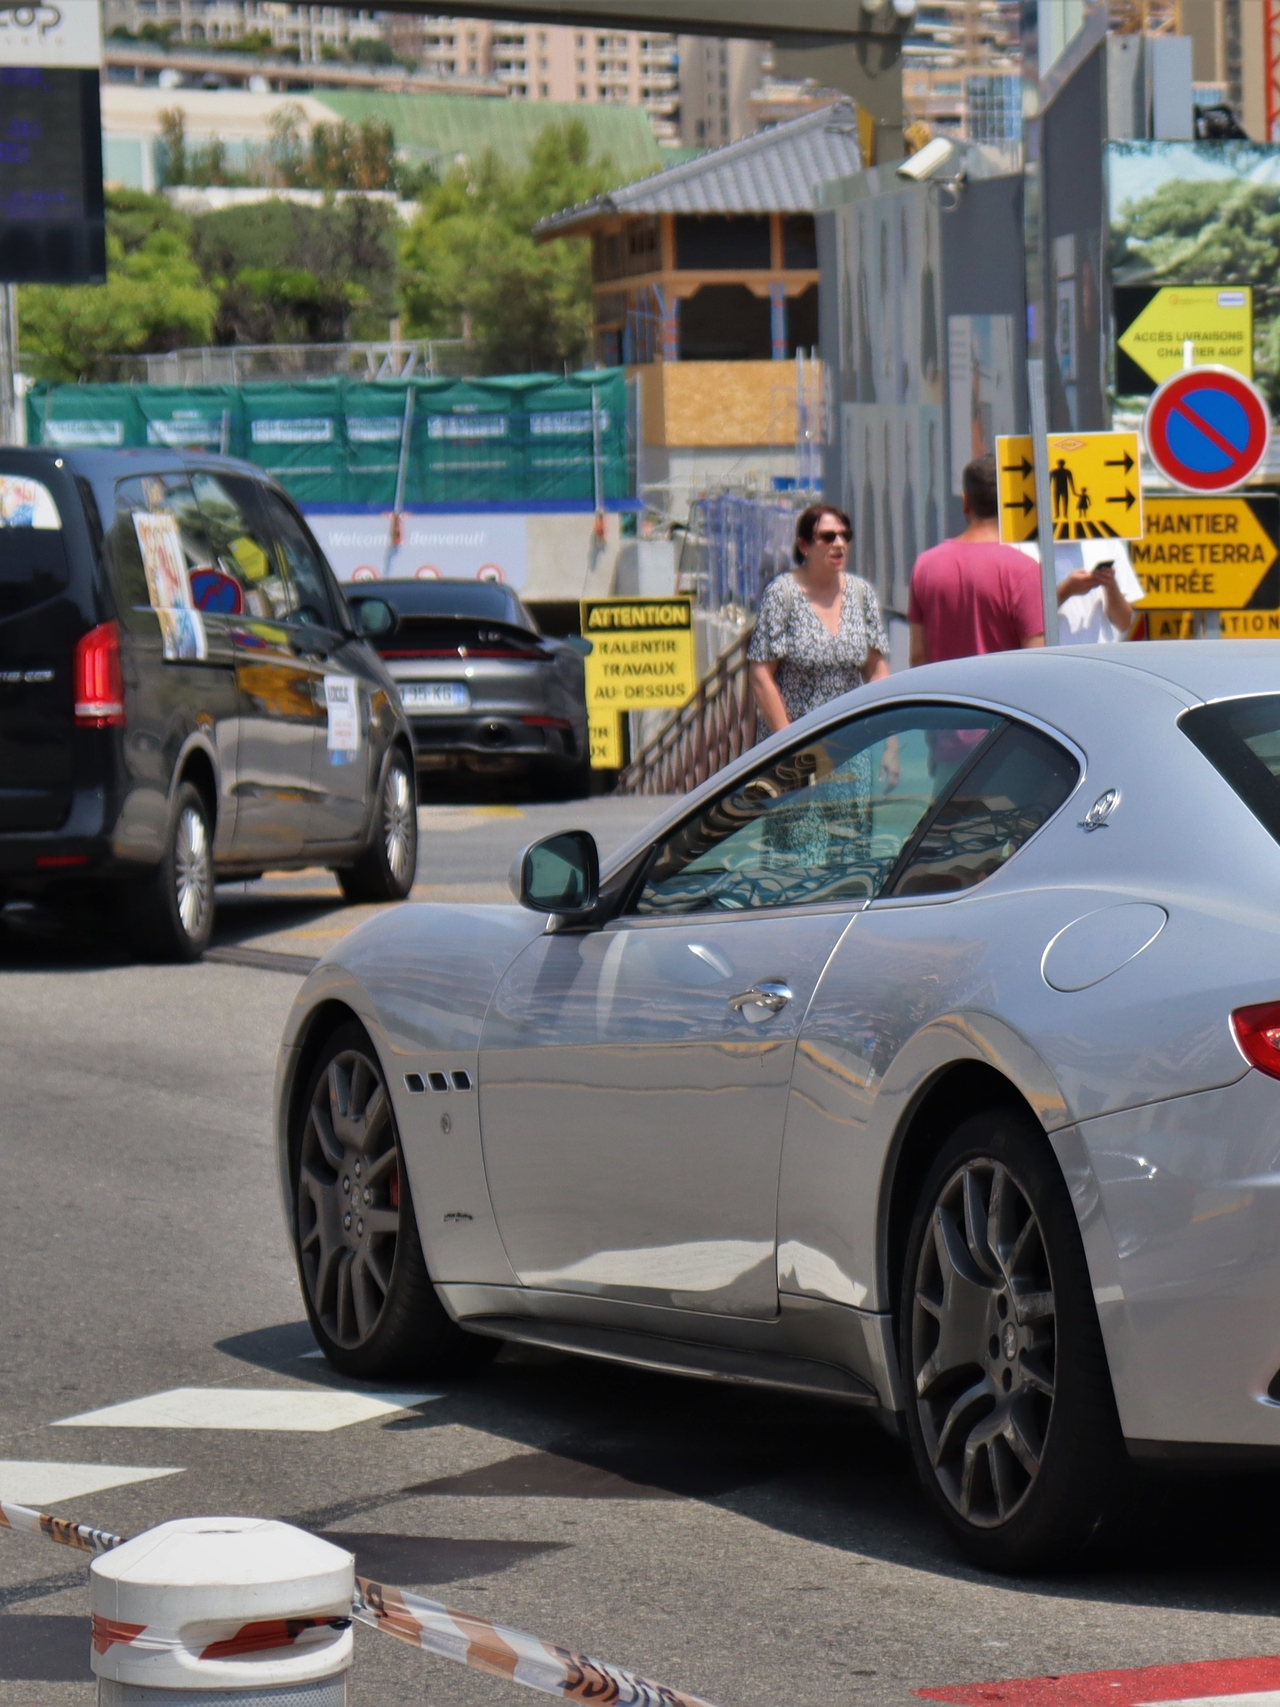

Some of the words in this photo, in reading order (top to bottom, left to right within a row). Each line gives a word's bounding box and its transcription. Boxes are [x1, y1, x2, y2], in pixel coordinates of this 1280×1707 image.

[1157, 346, 1215, 357] CHATIER
[1143, 514, 1238, 533] HANTIER
[328, 531, 390, 547] Welcom
[1132, 544, 1265, 563] MARETERRA
[588, 605, 687, 627] ATTENTION
[599, 640, 676, 654] RALENTIR
[602, 662, 675, 676] TRAVAUX
